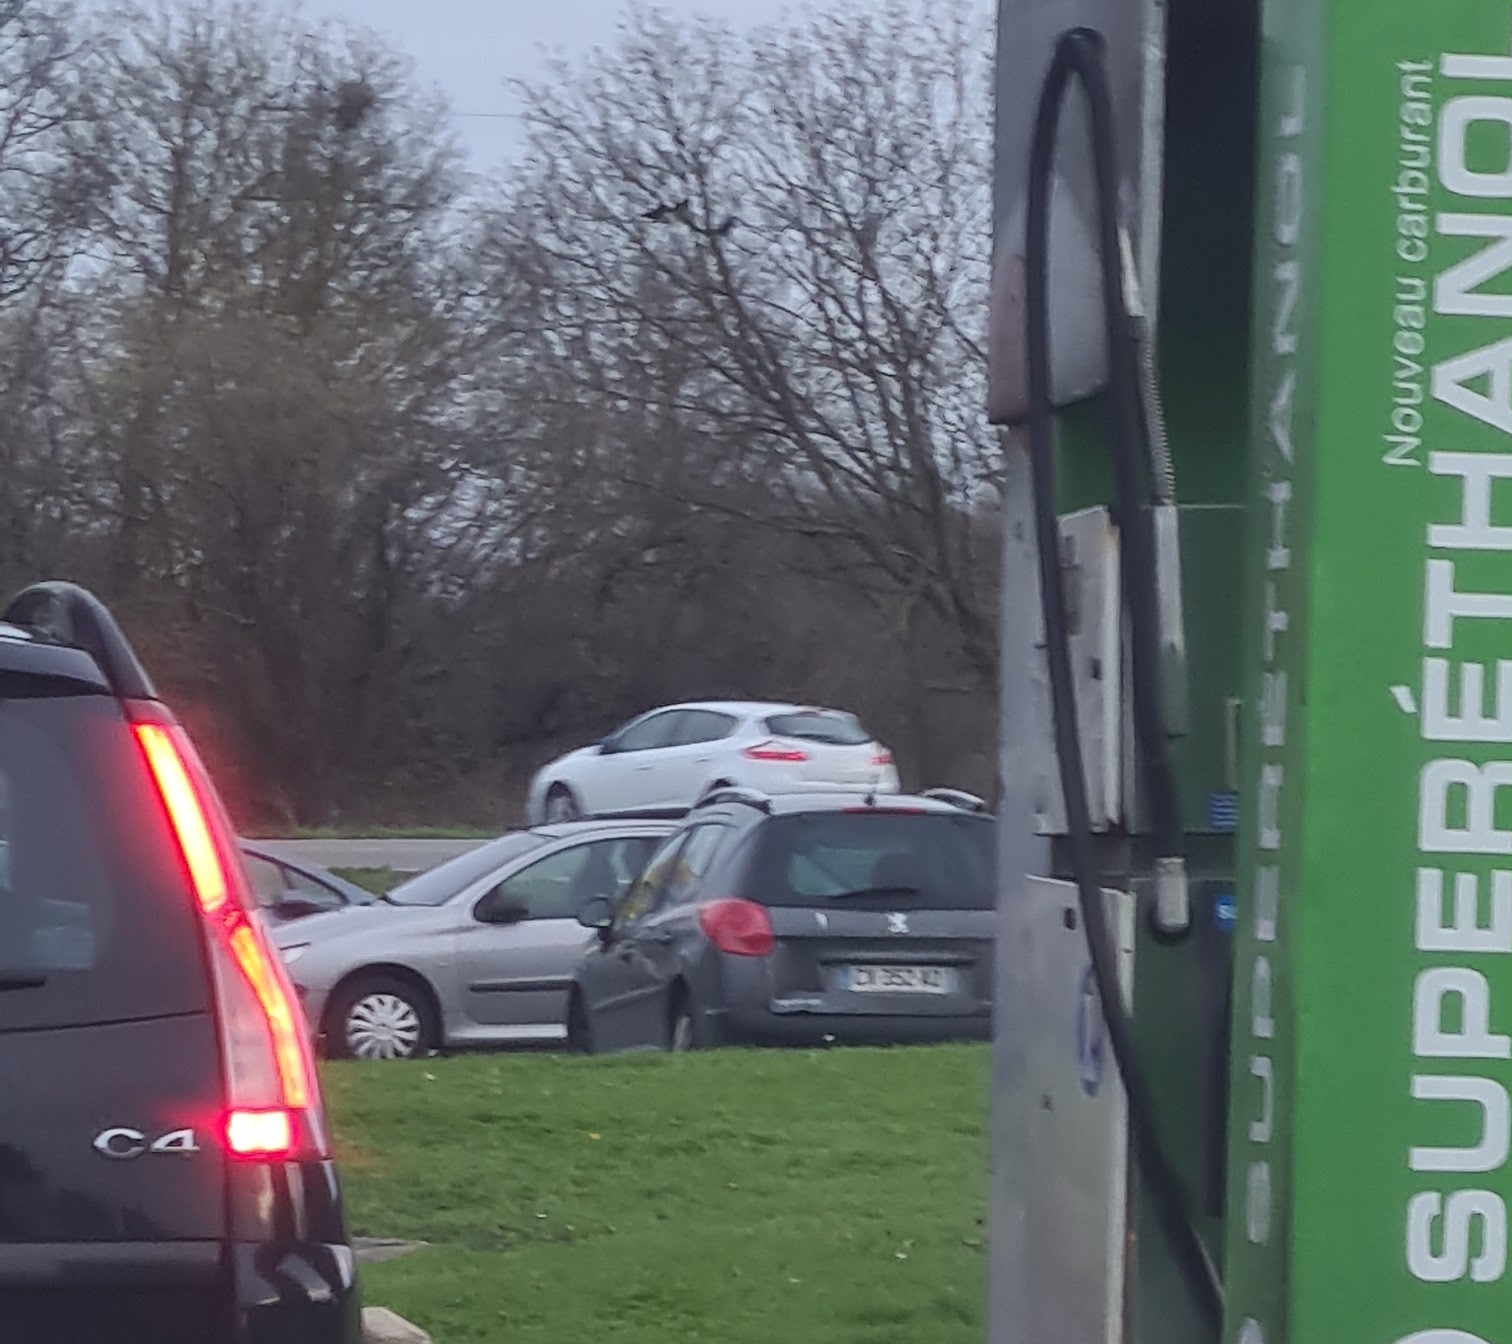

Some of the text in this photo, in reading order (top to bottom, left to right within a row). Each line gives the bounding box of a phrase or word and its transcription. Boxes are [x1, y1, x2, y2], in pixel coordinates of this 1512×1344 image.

[1382, 58, 1434, 467] Nouveau carburant
[93, 1127, 201, 1158] C4
